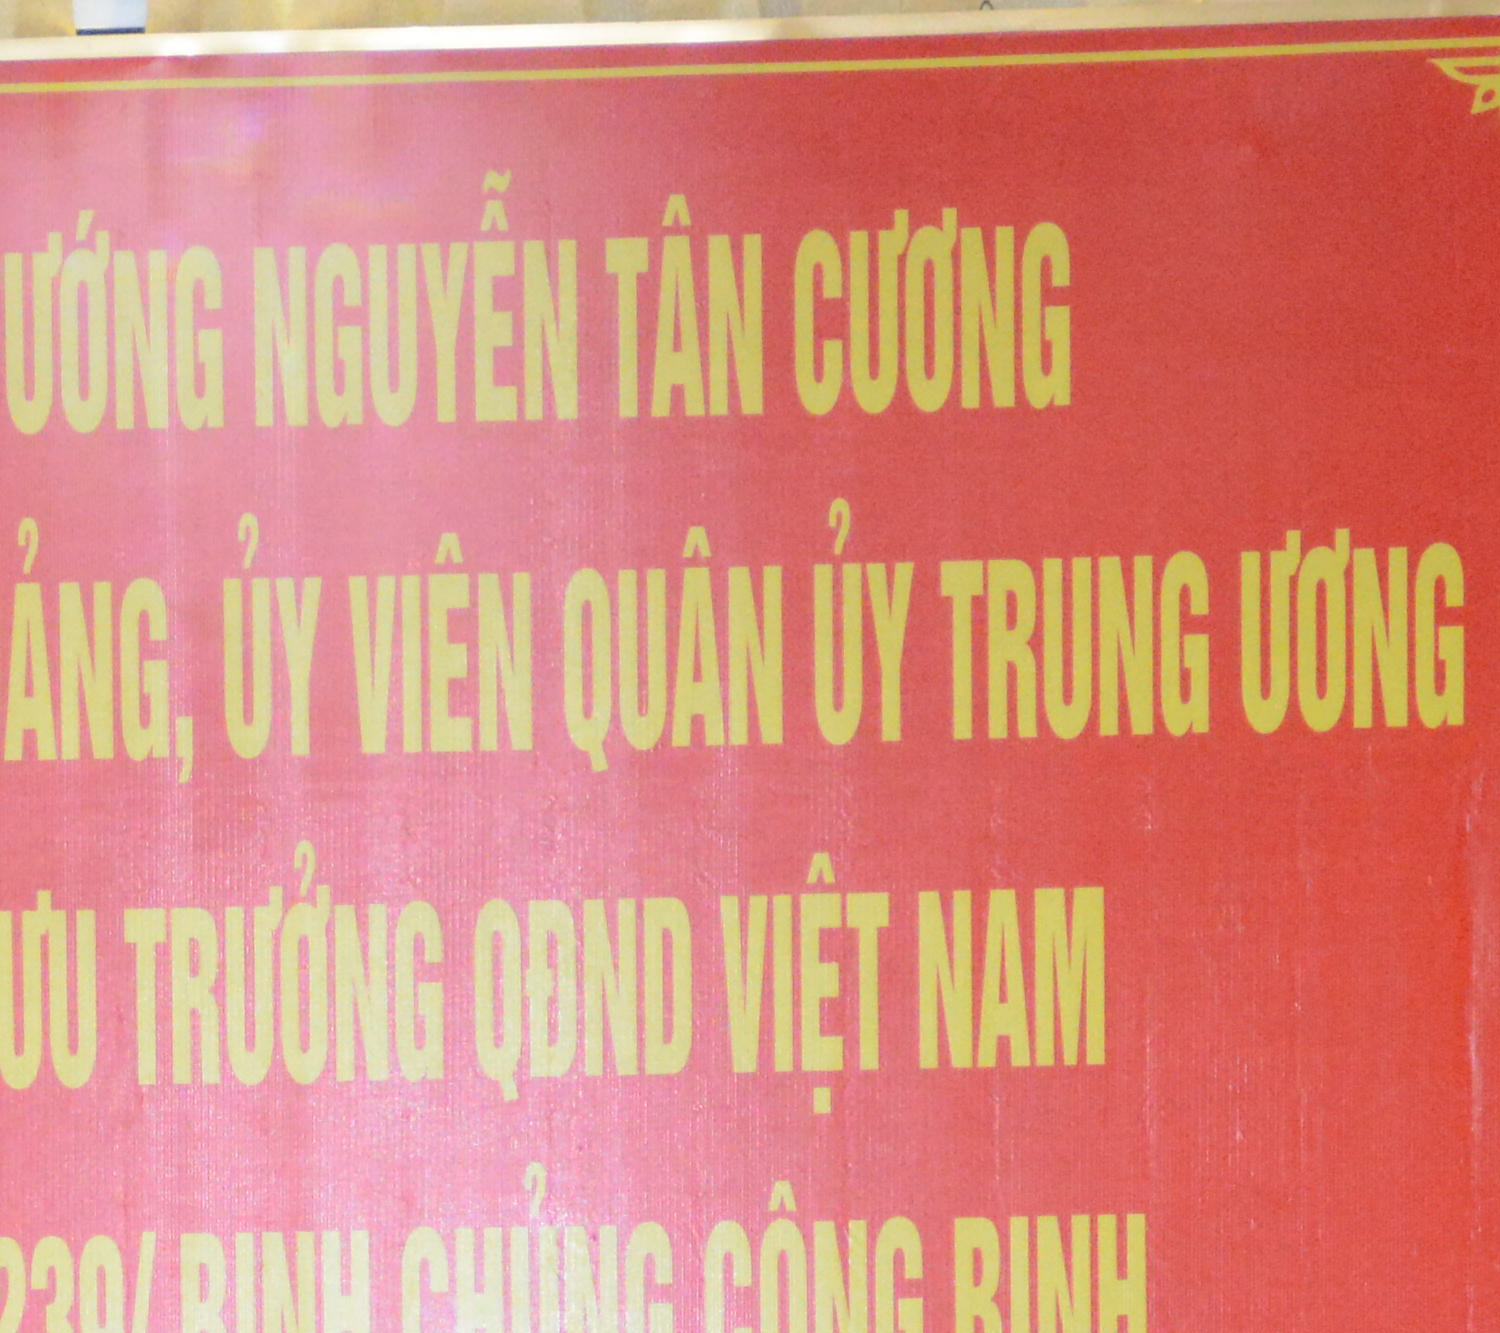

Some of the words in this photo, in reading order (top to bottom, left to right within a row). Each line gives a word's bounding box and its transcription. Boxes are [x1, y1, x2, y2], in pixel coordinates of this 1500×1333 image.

[255, 173, 578, 427] NGUYỄN
[607, 203, 763, 416] TÂN
[796, 211, 1070, 414] CƯƠNG
[223, 516, 321, 757] ỦY
[349, 536, 533, 752] VIÊN
[565, 529, 782, 770] QUÂN
[815, 501, 913, 743] ỦY
[942, 554, 1208, 738] TRUNG
[1242, 532, 1463, 732] ƯƠNG
[124, 844, 443, 1084] TRƯỞNG
[474, 899, 692, 1097] QĐND
[722, 855, 890, 1112] VIỆT
[920, 889, 1104, 1067] NAM
